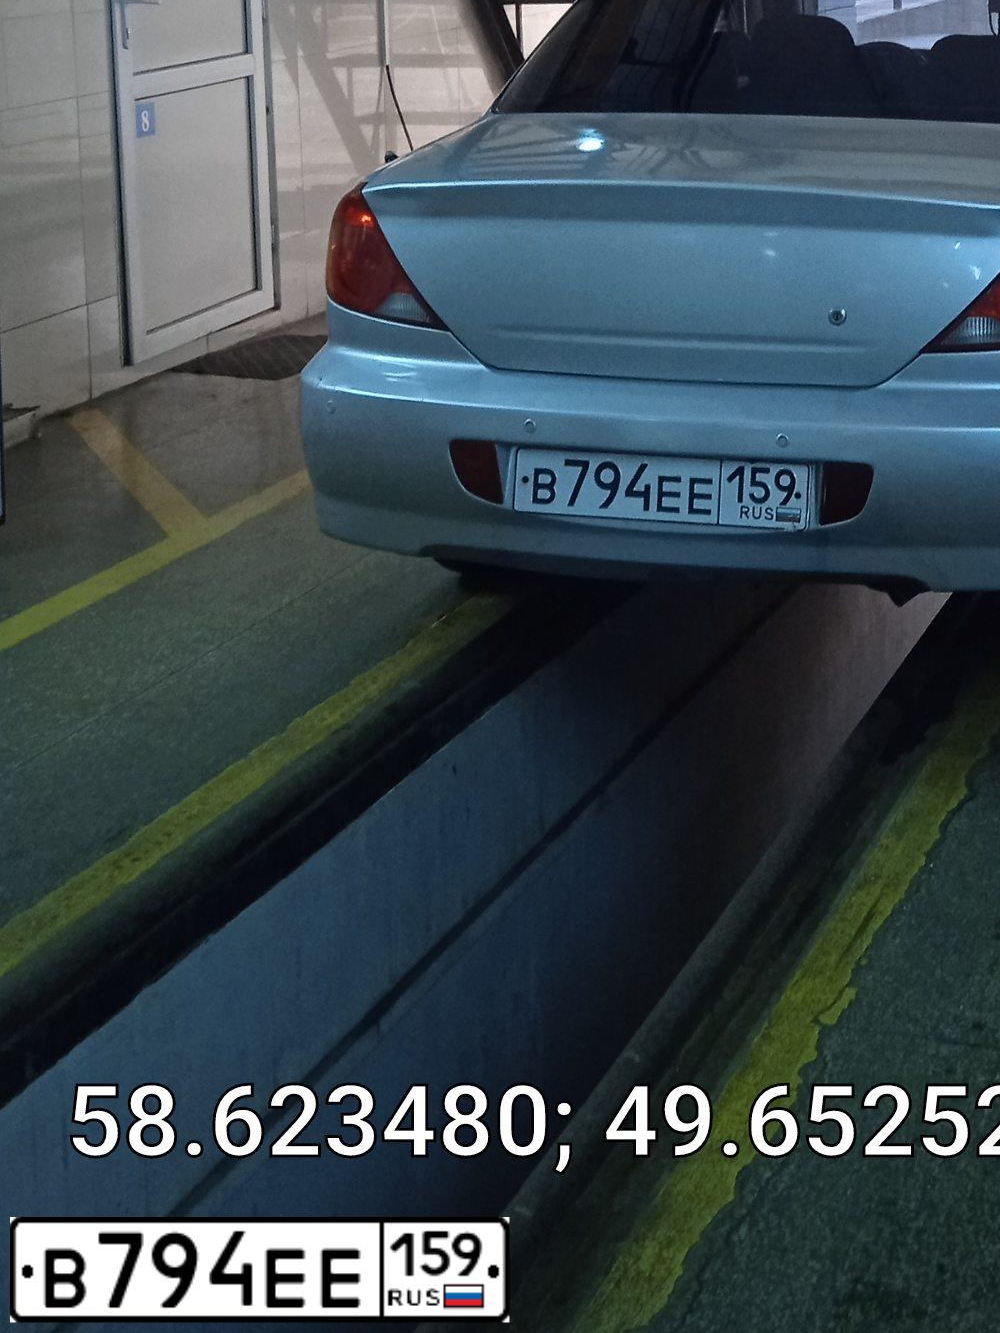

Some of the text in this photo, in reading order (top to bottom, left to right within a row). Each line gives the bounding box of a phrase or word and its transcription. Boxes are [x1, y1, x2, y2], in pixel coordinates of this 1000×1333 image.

[141, 110, 150, 132] 8
[726, 466, 798, 507] 159
[738, 505, 775, 522] RUS
